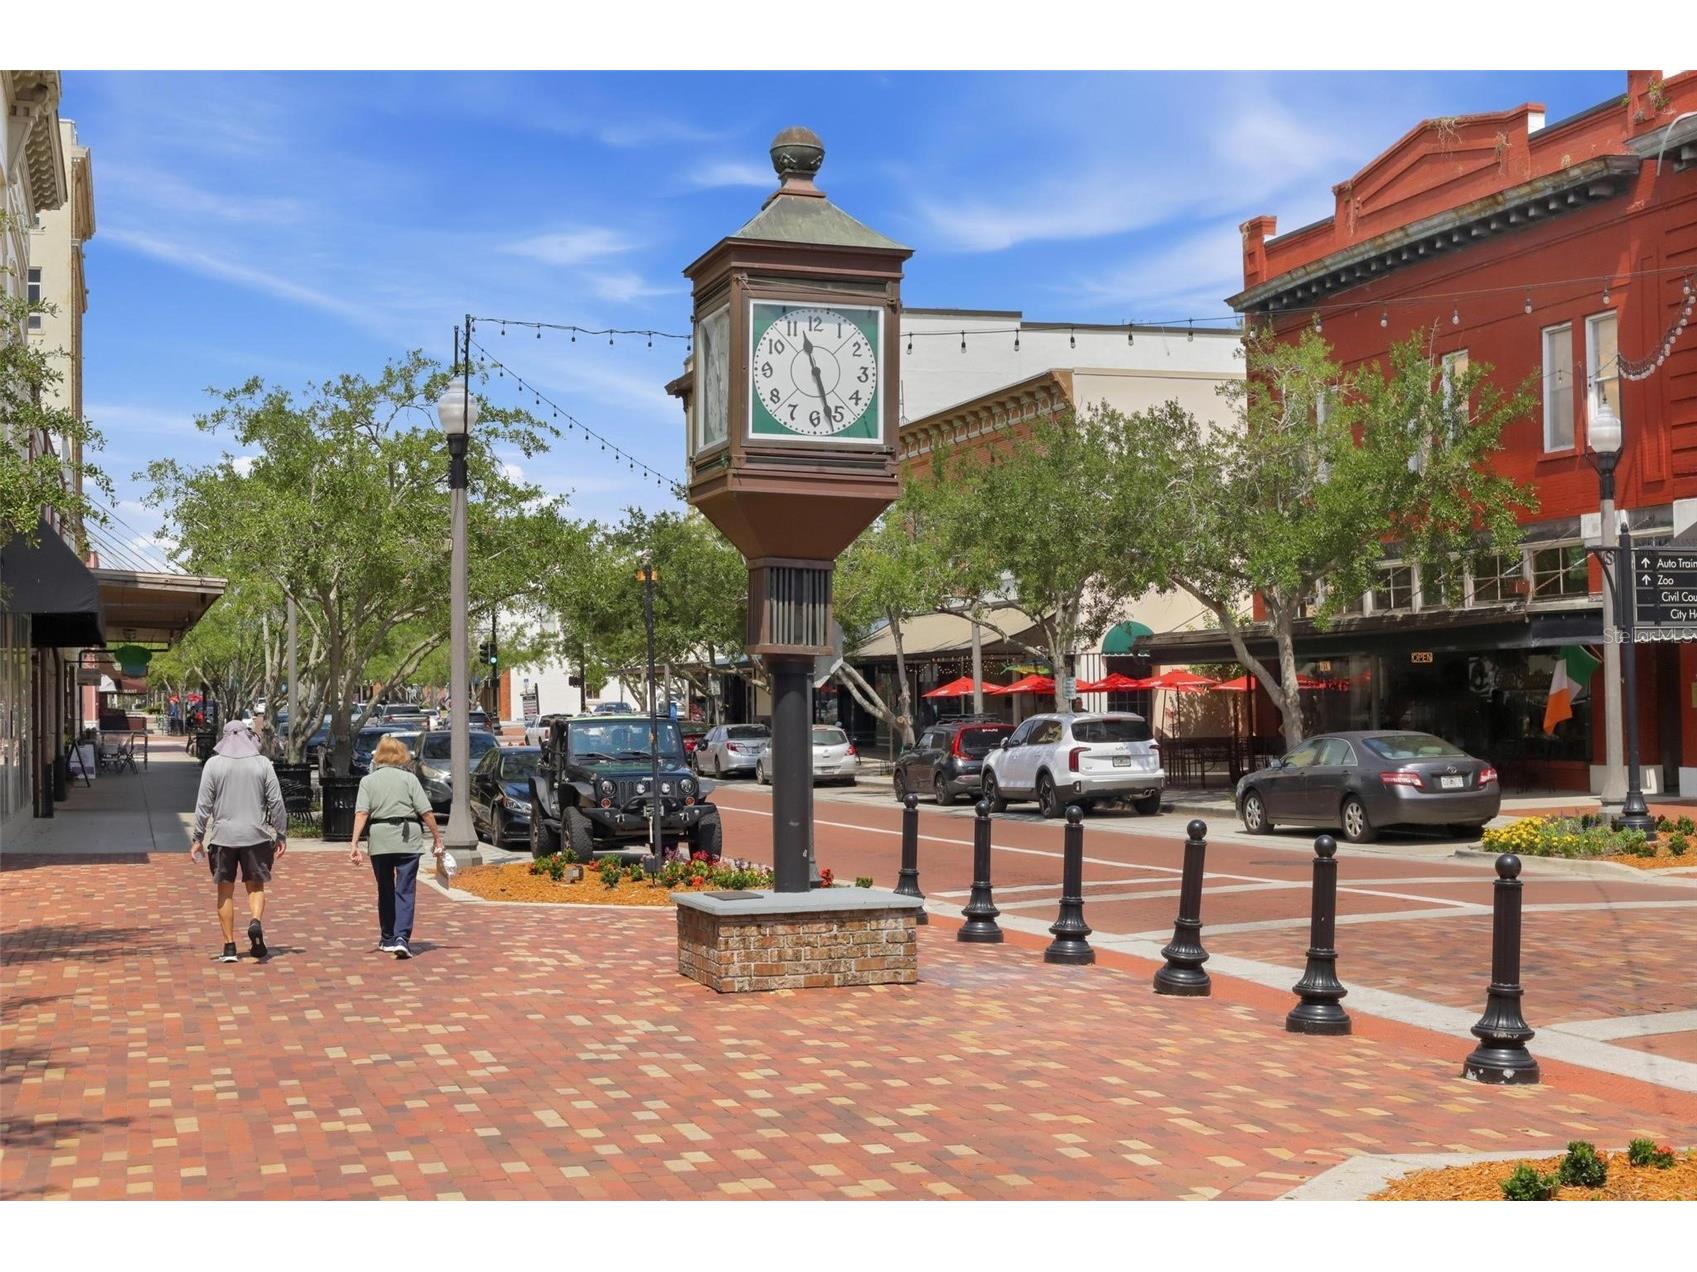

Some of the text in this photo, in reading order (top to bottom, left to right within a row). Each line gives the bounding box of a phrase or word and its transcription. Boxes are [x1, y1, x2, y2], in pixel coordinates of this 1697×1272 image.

[787, 320, 798, 337] 11
[808, 315, 824, 332] 12
[837, 322, 842, 339] 1
[769, 338, 785, 355] 10
[852, 341, 862, 357] 2
[761, 361, 773, 378] 9
[857, 366, 869, 383] 3
[769, 388, 781, 404] 8
[848, 389, 862, 406] 4
[787, 404, 799, 421] 7
[809, 410, 820, 427] 6
[832, 406, 844, 423] 5
[1657, 558, 1697, 568] Auto Train
[1658, 575, 1674, 585] Zoo
[1662, 591, 1697, 602] Civil Cou
[1670, 609, 1687, 621] City
[1411, 652, 1433, 663] OPEN
